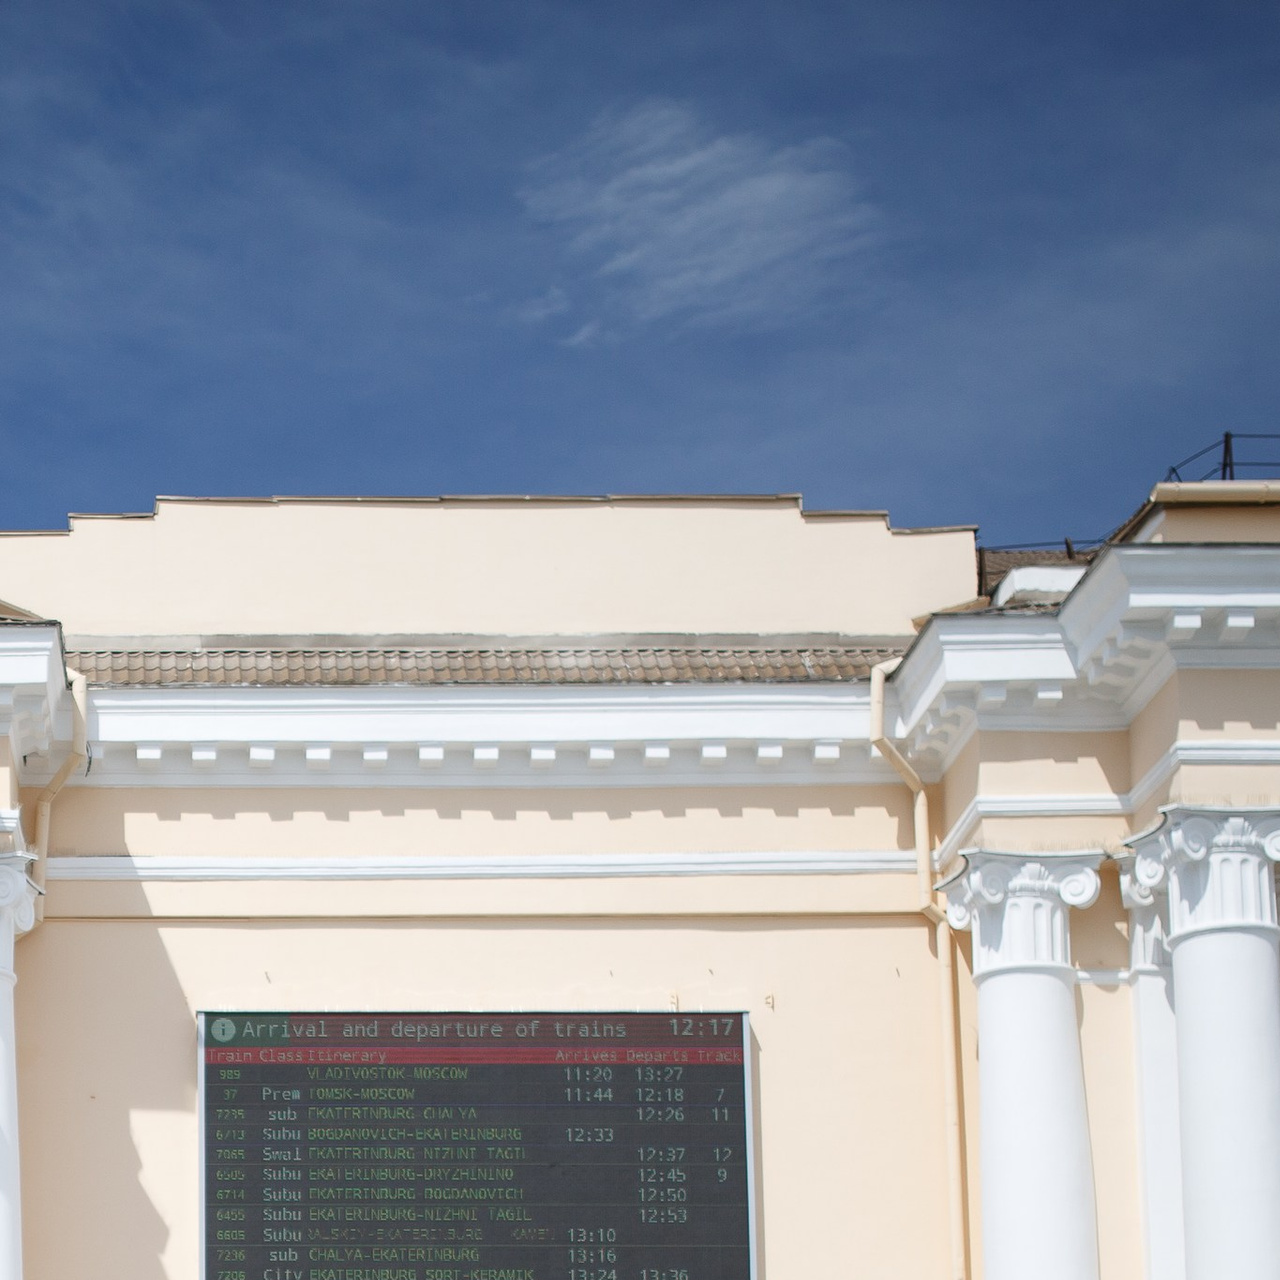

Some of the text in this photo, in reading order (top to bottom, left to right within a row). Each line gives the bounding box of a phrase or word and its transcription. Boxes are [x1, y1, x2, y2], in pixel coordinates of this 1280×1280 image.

[242, 1018, 734, 1041] Arrival and departure of trains 12:17
[208, 1050, 741, 1064] Train Class Itinerary Arrives Departs Track
[564, 1068, 613, 1082] 11:20
[635, 1068, 683, 1082] 13:27
[262, 1087, 301, 1101] Prem
[309, 1088, 415, 1101] TOMSK-MOSCOW
[564, 1088, 613, 1102] 11:44
[635, 1088, 684, 1102] 12:18
[716, 1088, 725, 1102] 7
[268, 1107, 297, 1121] sub
[636, 1107, 685, 1122] 12:26
[712, 1107, 729, 1122] 11
[262, 1127, 301, 1141] Subu
[565, 1128, 614, 1142] 12:33
[262, 1148, 302, 1161] Swal
[637, 1148, 686, 1162] 12:37
[714, 1148, 732, 1162] 12
[262, 1167, 302, 1181] Subu
[638, 1169, 686, 1183] 12:45
[717, 1169, 728, 1183] 9
[262, 1188, 302, 1202] Subu
[638, 1188, 687, 1202] 12:50
[263, 1208, 302, 1222] Subu
[489, 1208, 532, 1221] TAGIL
[639, 1209, 687, 1223] 12:53
[263, 1228, 302, 1242] Subu
[568, 1229, 616, 1242] 13:10
[269, 1248, 298, 1262] sub
[309, 1248, 480, 1262] CHALYA-EKATERINBURG
[569, 1249, 617, 1263] 13:16
